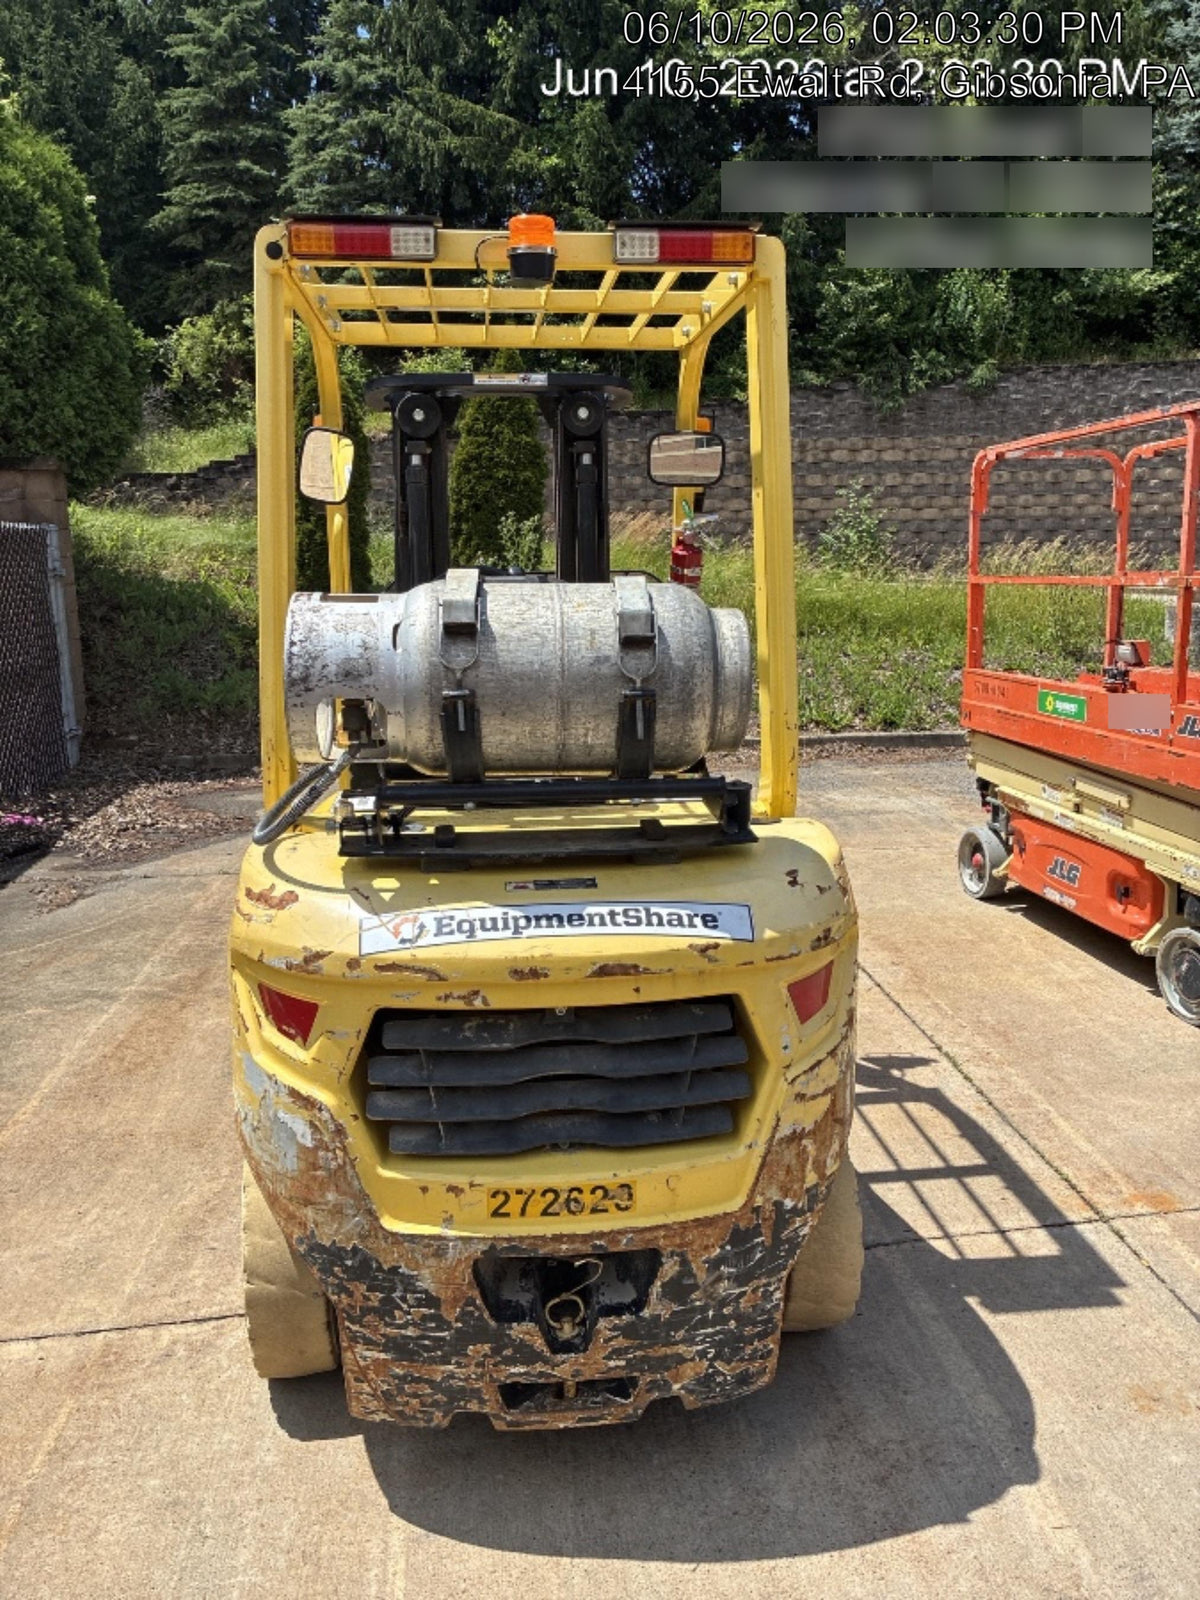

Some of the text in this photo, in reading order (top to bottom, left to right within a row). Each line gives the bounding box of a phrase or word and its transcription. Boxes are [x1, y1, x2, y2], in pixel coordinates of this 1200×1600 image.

[1176, 715, 1200, 738] JL
[1047, 857, 1081, 887] JLG
[433, 907, 718, 939] EquipmentShare
